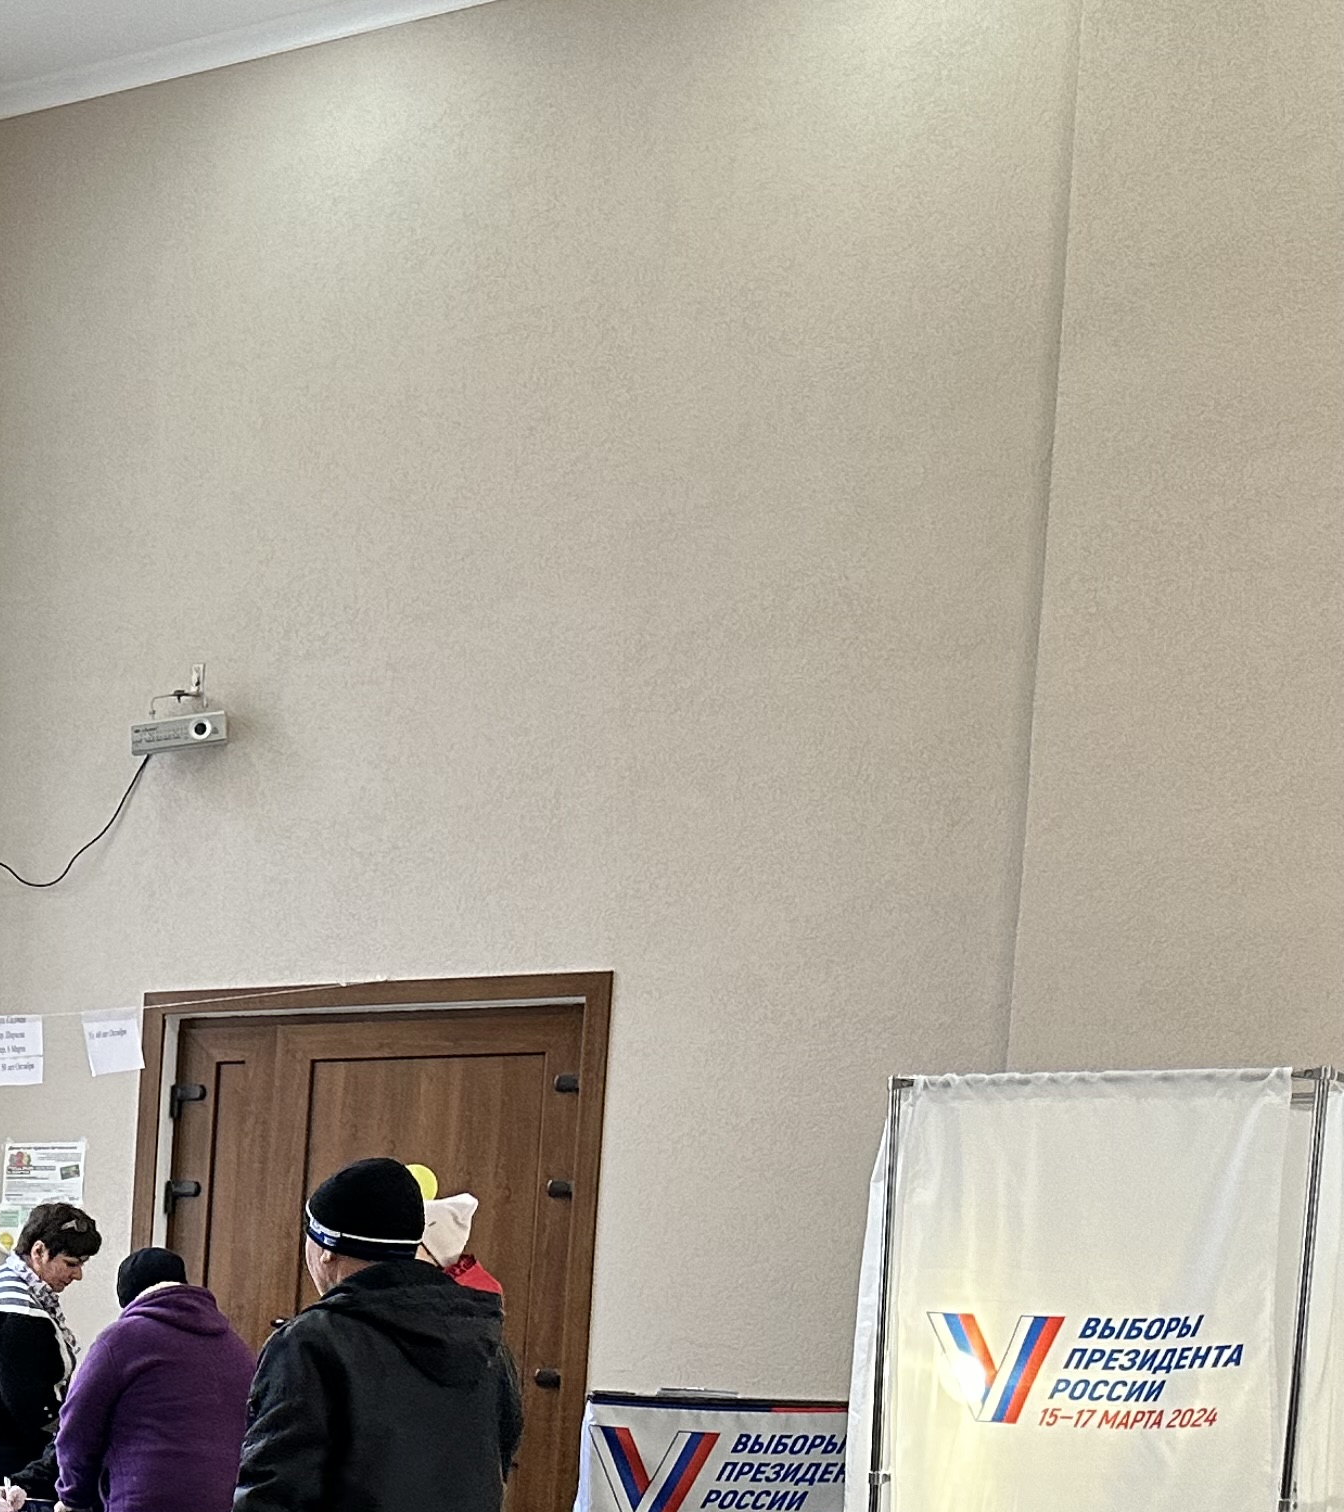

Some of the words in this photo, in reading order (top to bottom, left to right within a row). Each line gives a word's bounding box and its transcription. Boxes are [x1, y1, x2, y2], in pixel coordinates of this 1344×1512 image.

[1078, 1314, 1205, 1340] ВЫБОРЫ
[1063, 1344, 1245, 1375] ПРЕЗИДЕНТА
[1048, 1379, 1167, 1402] РОССИИ
[1099, 1409, 1163, 1429] МАРТА
[1165, 1408, 1218, 1428] 2024
[731, 1433, 847, 1455] ВЫБОРЫ
[700, 1490, 809, 1511] РОССИИ
